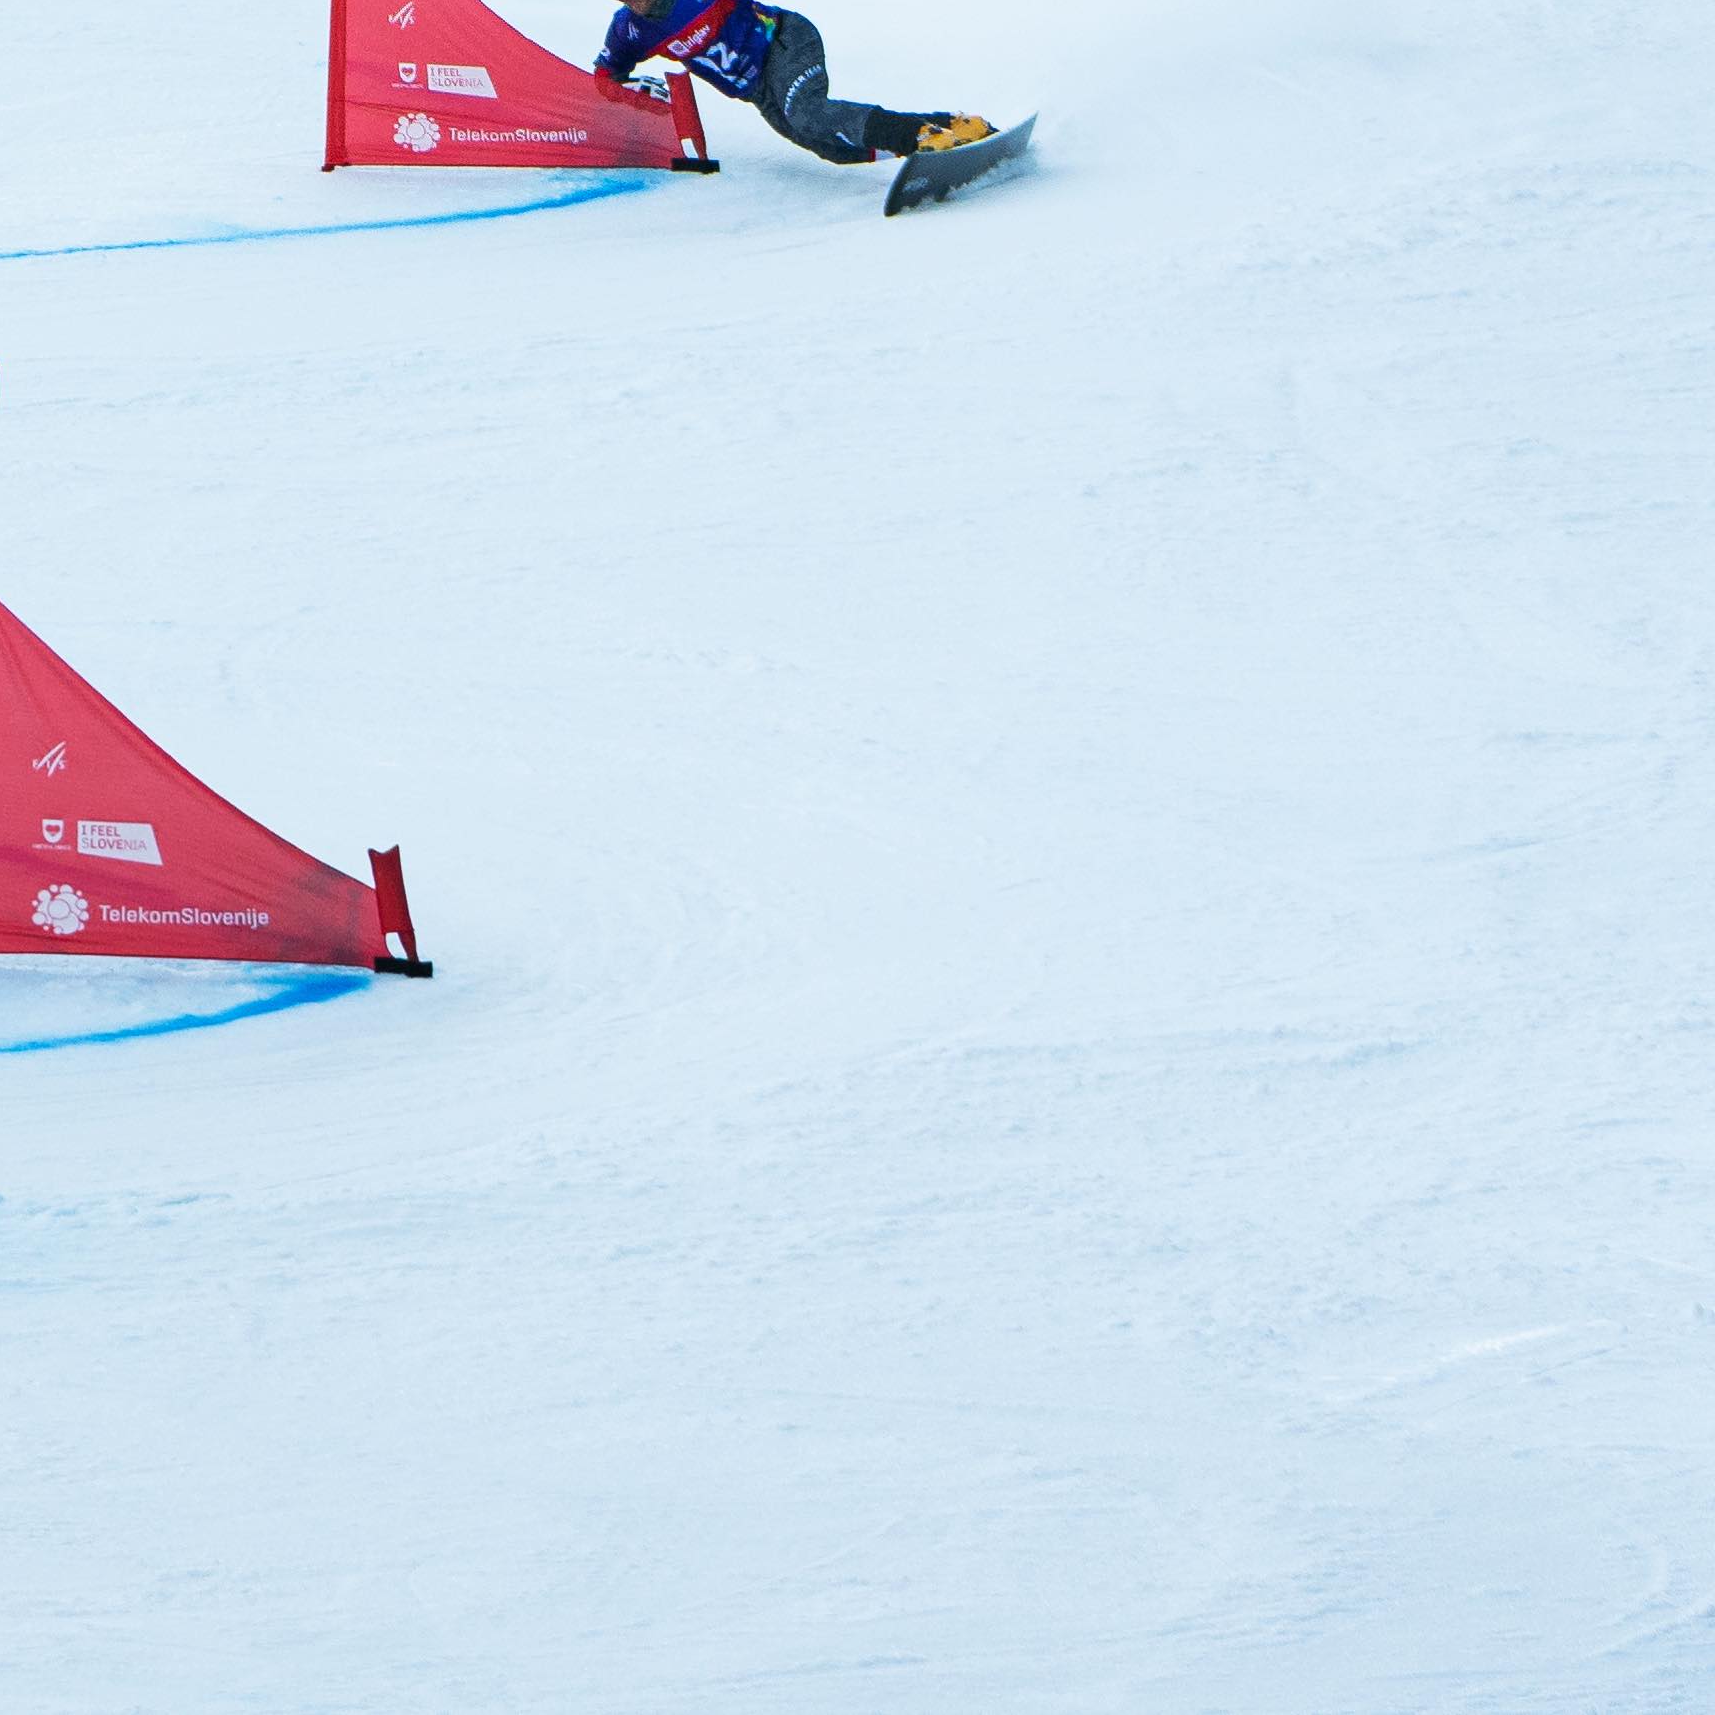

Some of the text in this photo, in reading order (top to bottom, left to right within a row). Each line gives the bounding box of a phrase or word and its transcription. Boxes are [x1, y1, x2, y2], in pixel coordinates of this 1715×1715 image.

[437, 67, 462, 77] FEEL
[430, 77, 484, 88] SLOVENIA
[448, 124, 588, 147] TelekomSlovenije
[81, 824, 121, 837] I FEEL
[81, 837, 148, 852] SLOVENIA
[99, 903, 270, 931] TelekomSlovenije
